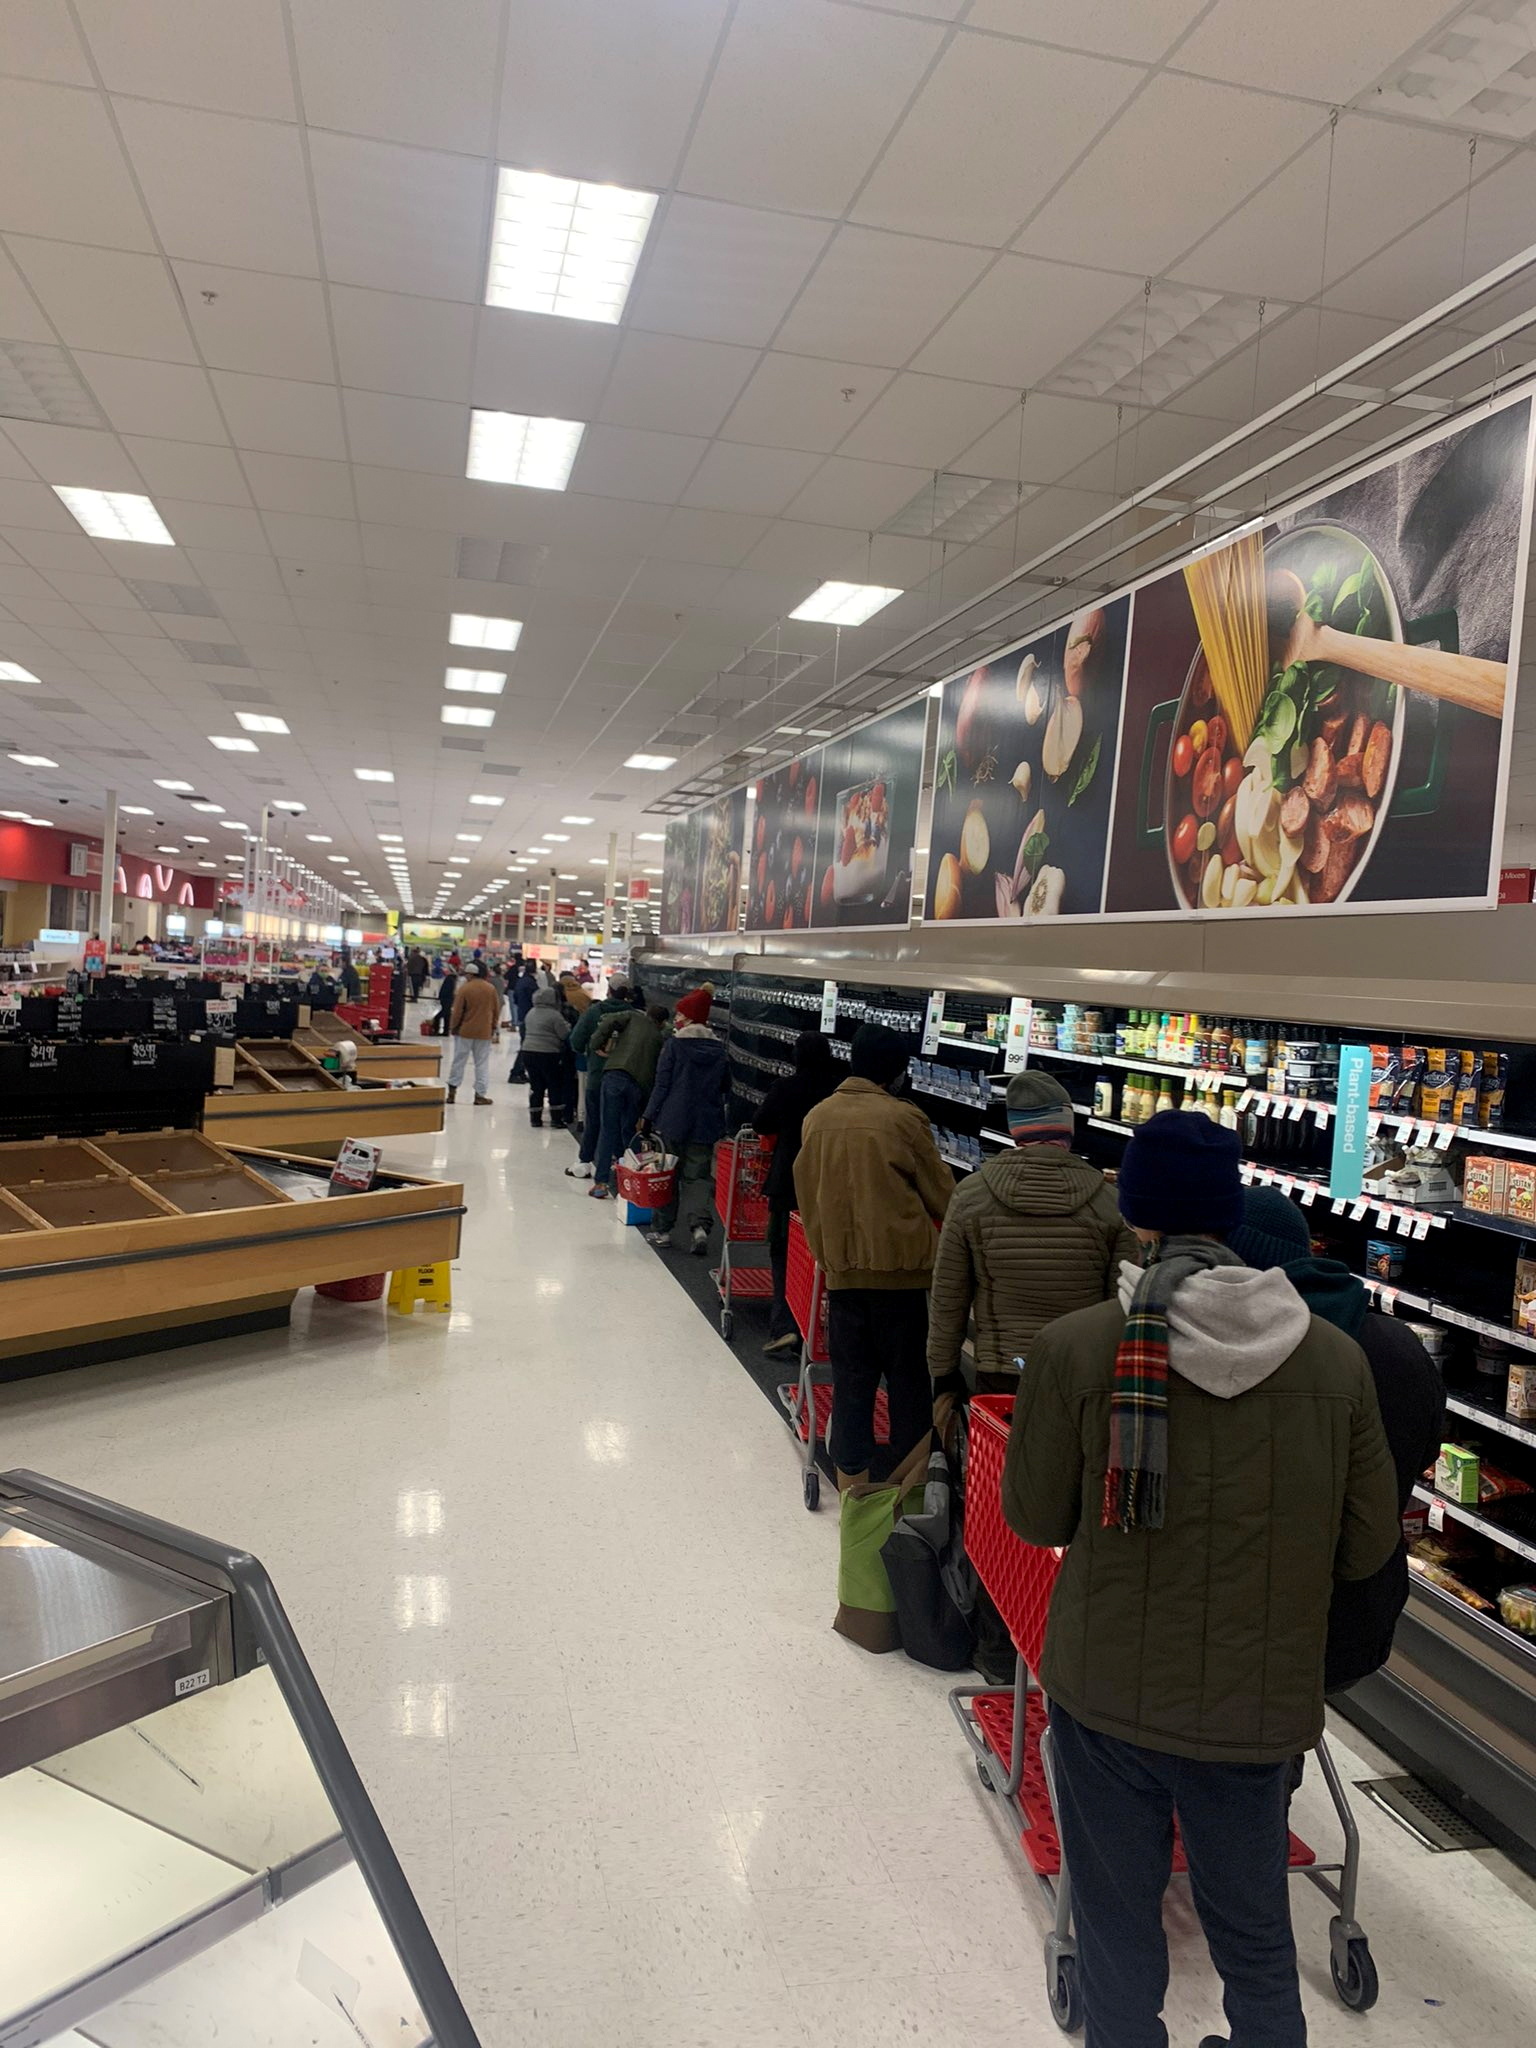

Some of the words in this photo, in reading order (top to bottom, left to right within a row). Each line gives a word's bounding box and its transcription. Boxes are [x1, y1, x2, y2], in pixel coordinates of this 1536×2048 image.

[1342, 1057, 1364, 1153] Plant-based
[1470, 1171, 1489, 1181] SEITAN
[179, 1679, 195, 1692] B22
[197, 1674, 207, 1685] T2
